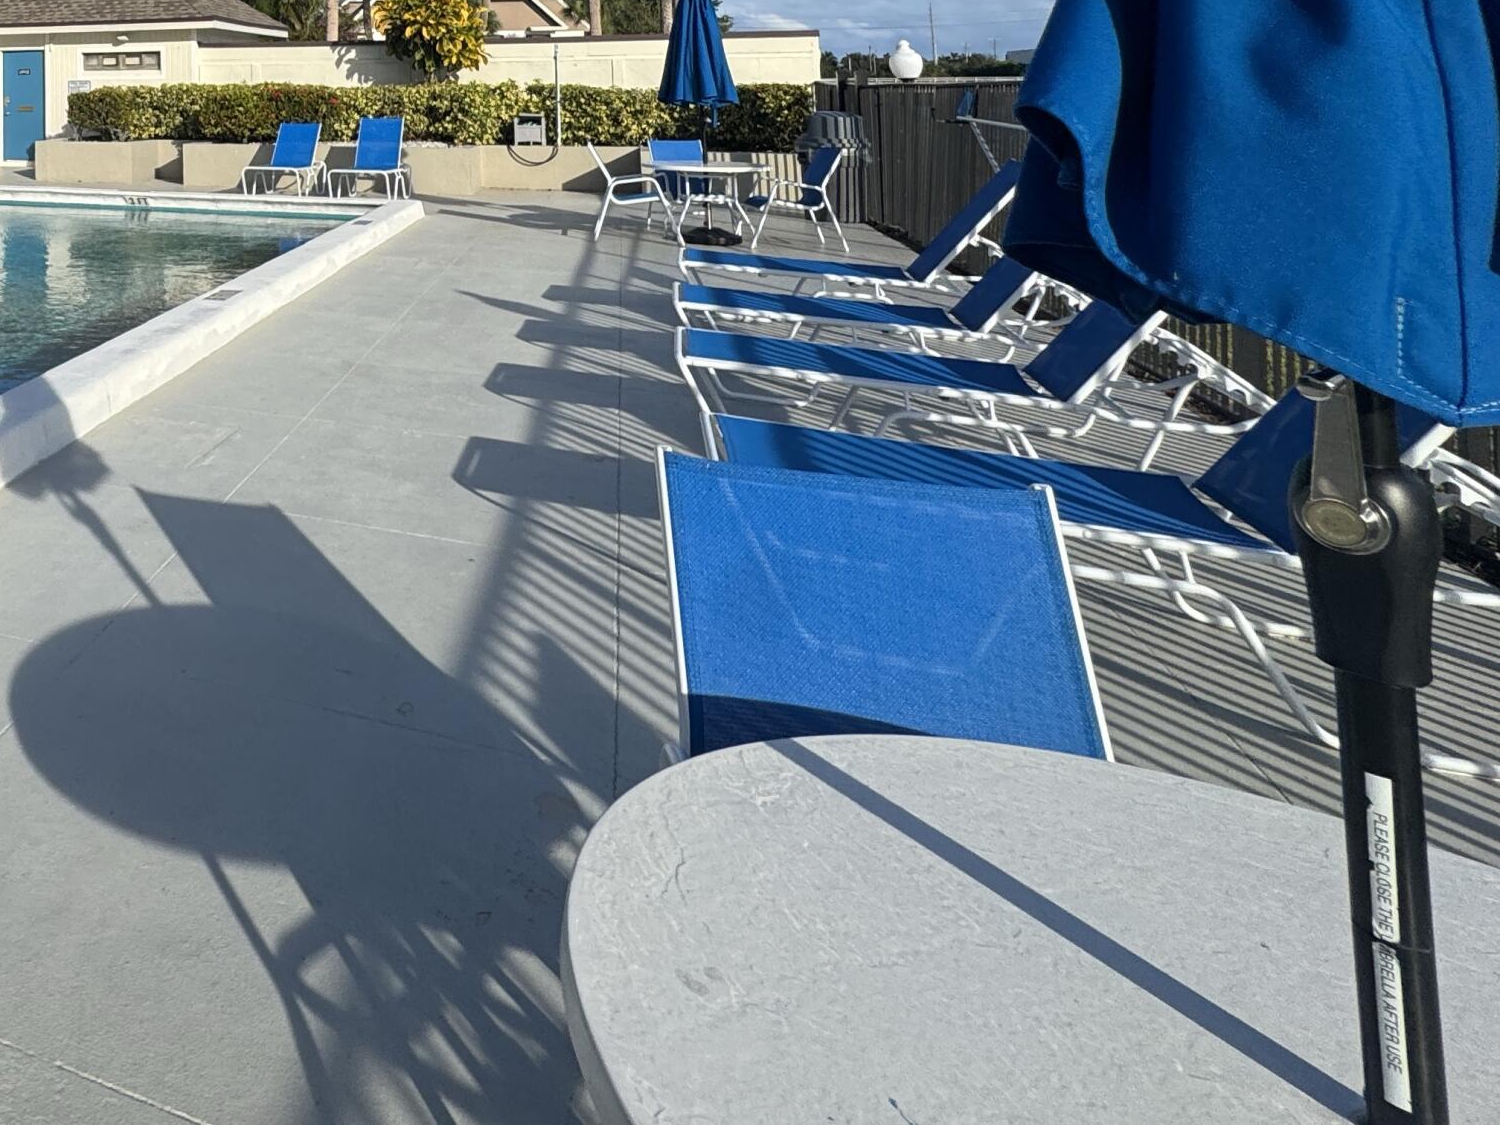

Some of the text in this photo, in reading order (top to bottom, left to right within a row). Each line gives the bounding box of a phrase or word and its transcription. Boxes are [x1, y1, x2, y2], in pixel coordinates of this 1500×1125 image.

[1373, 811, 1390, 862] PLEASE
[1375, 861, 1393, 907] CLOSE
[1378, 906, 1395, 936] THE
[1382, 998, 1400, 1045] AFTER
[1386, 1043, 1403, 1075] USE
